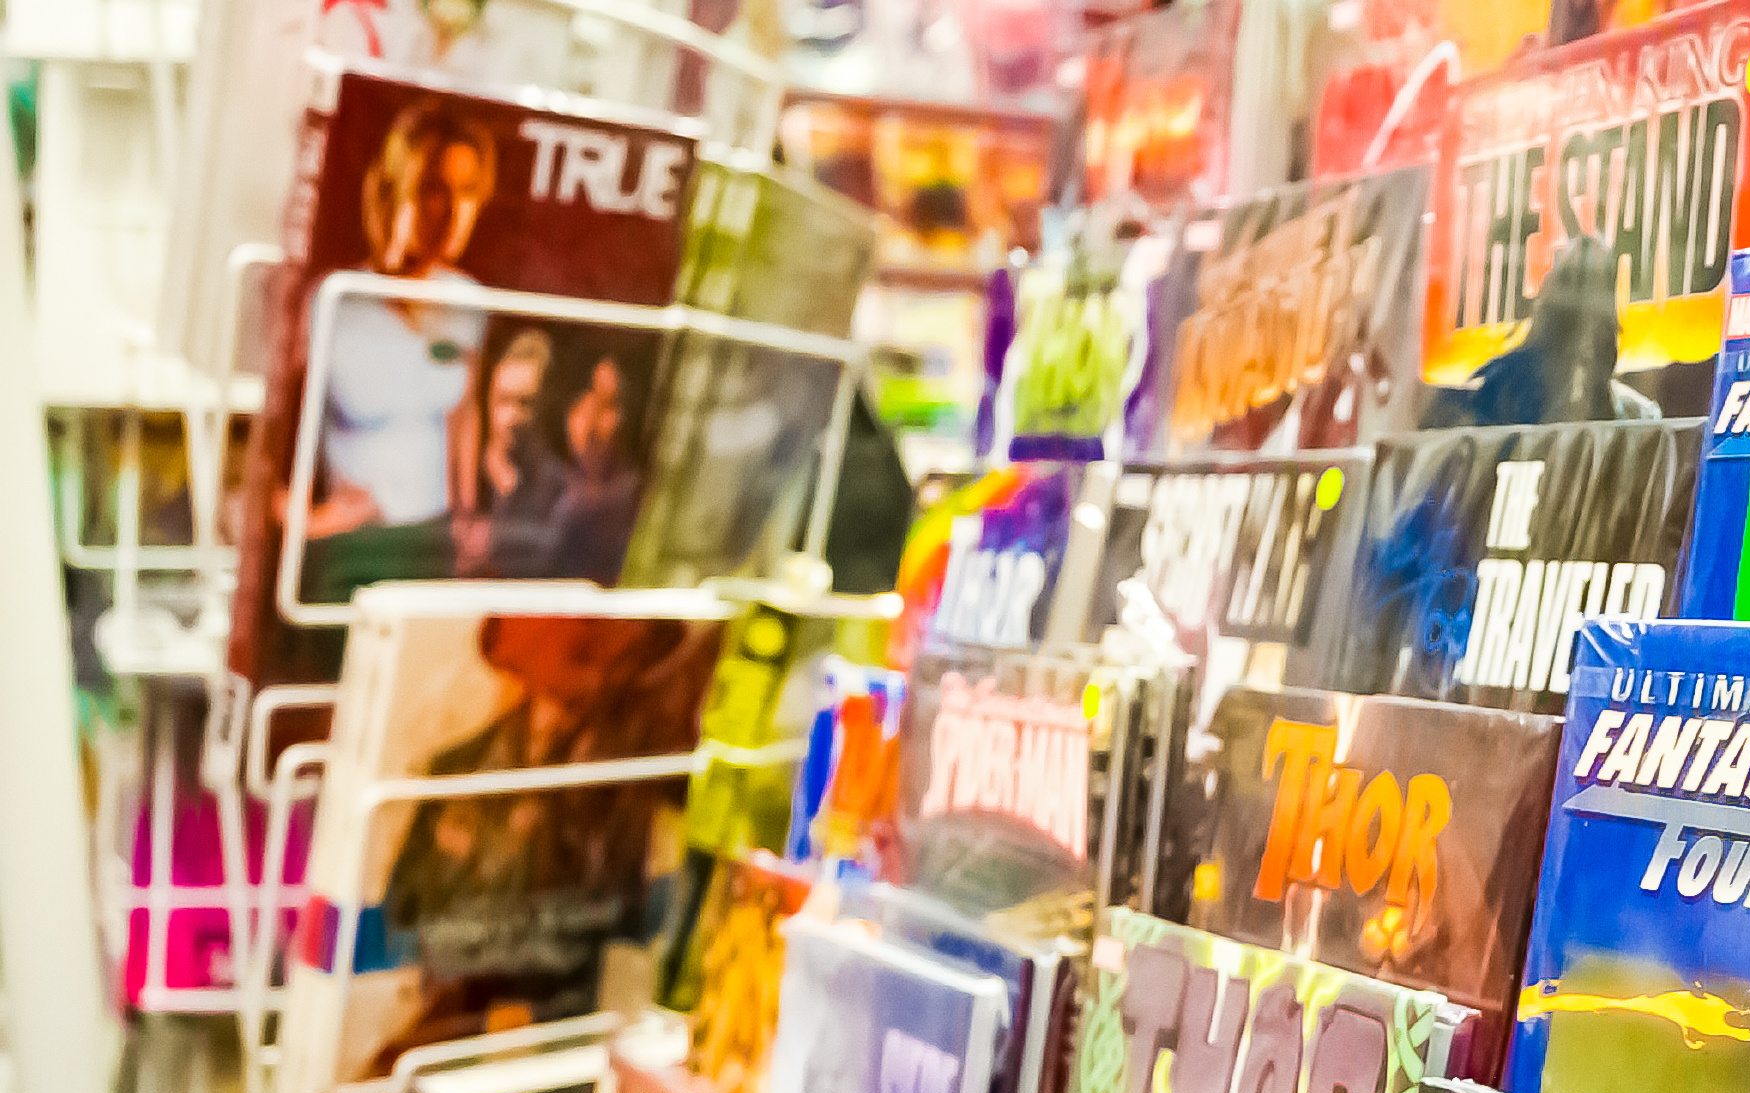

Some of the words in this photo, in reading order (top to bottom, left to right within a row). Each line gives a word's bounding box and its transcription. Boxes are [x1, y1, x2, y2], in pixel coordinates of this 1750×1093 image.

[517, 117, 686, 221] TRUE
[1454, 146, 1546, 329] THE
[1557, 98, 1741, 304] STAND
[1485, 460, 1546, 550] THE
[1252, 716, 1452, 937] THOR
